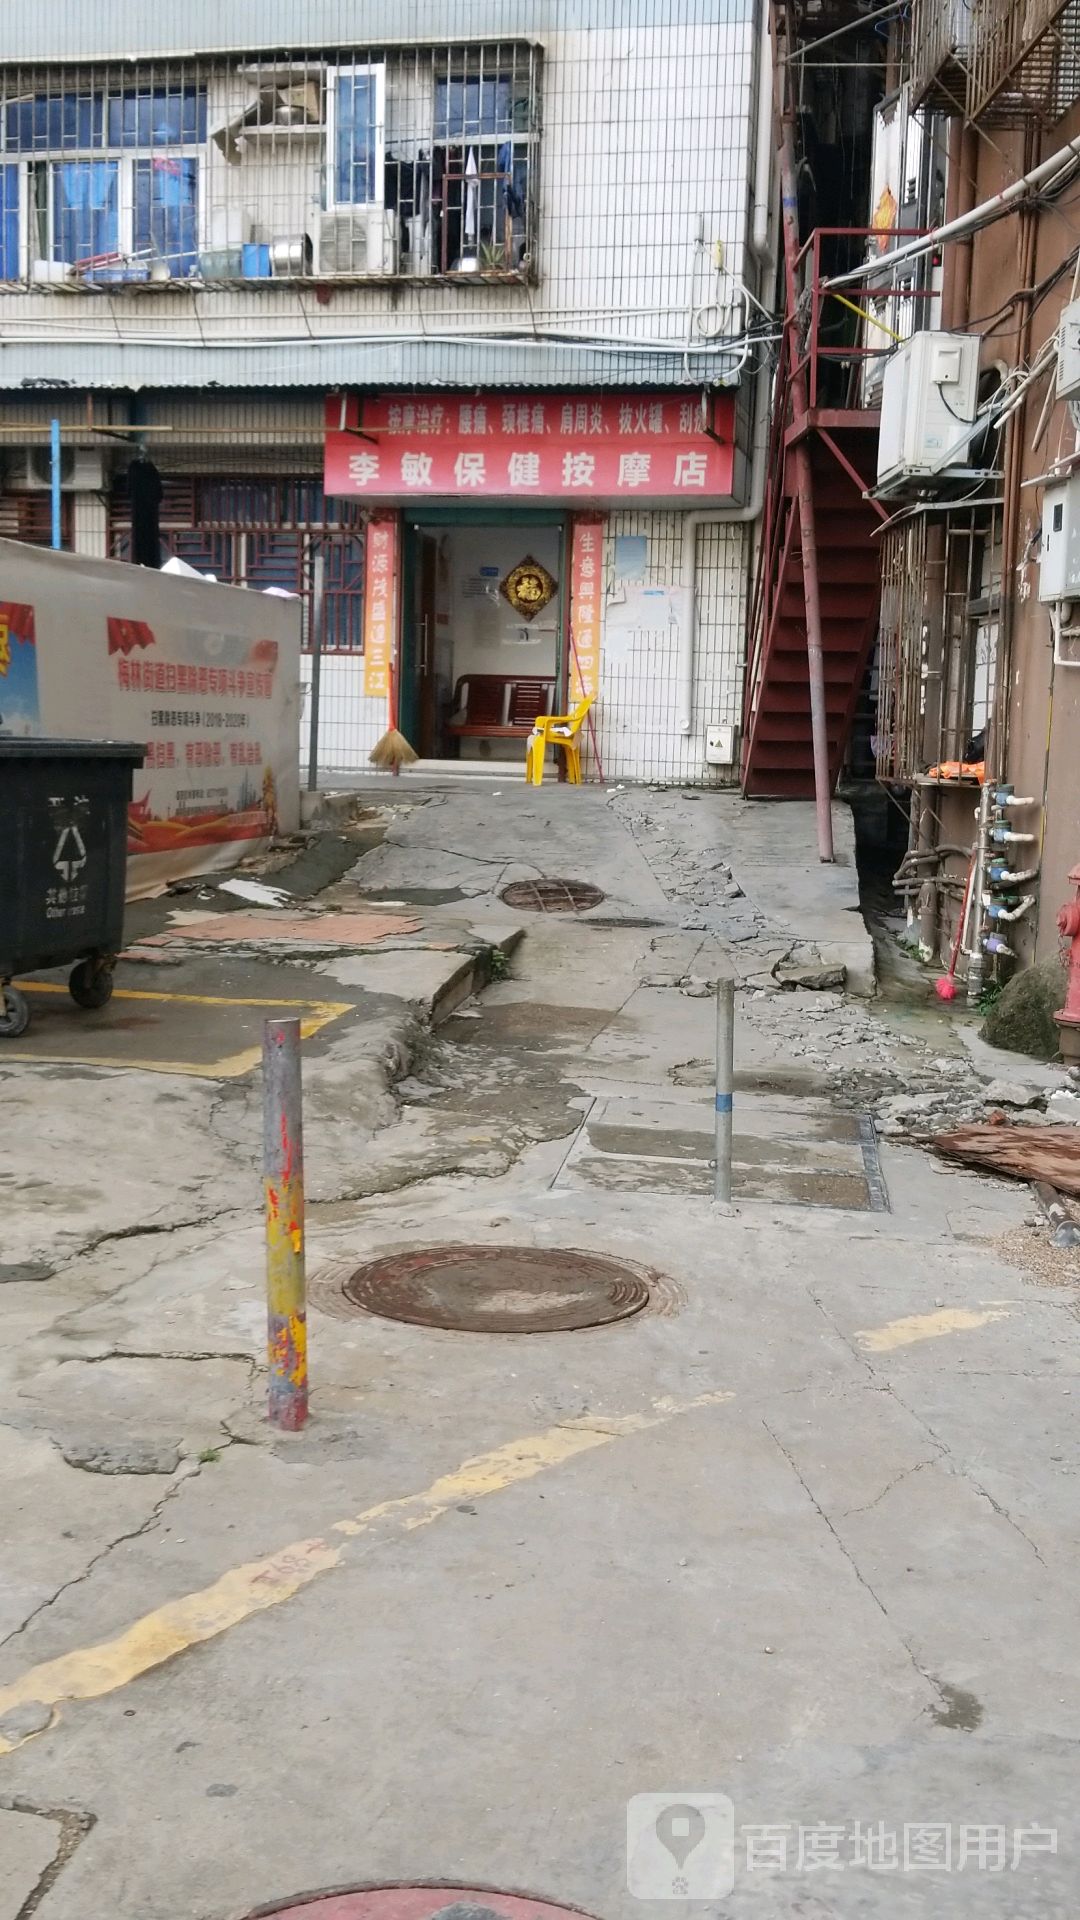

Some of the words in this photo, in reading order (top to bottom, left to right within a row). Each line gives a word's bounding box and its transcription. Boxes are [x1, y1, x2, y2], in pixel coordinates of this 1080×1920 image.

[348, 451, 708, 488] 李敏保健按摩店
